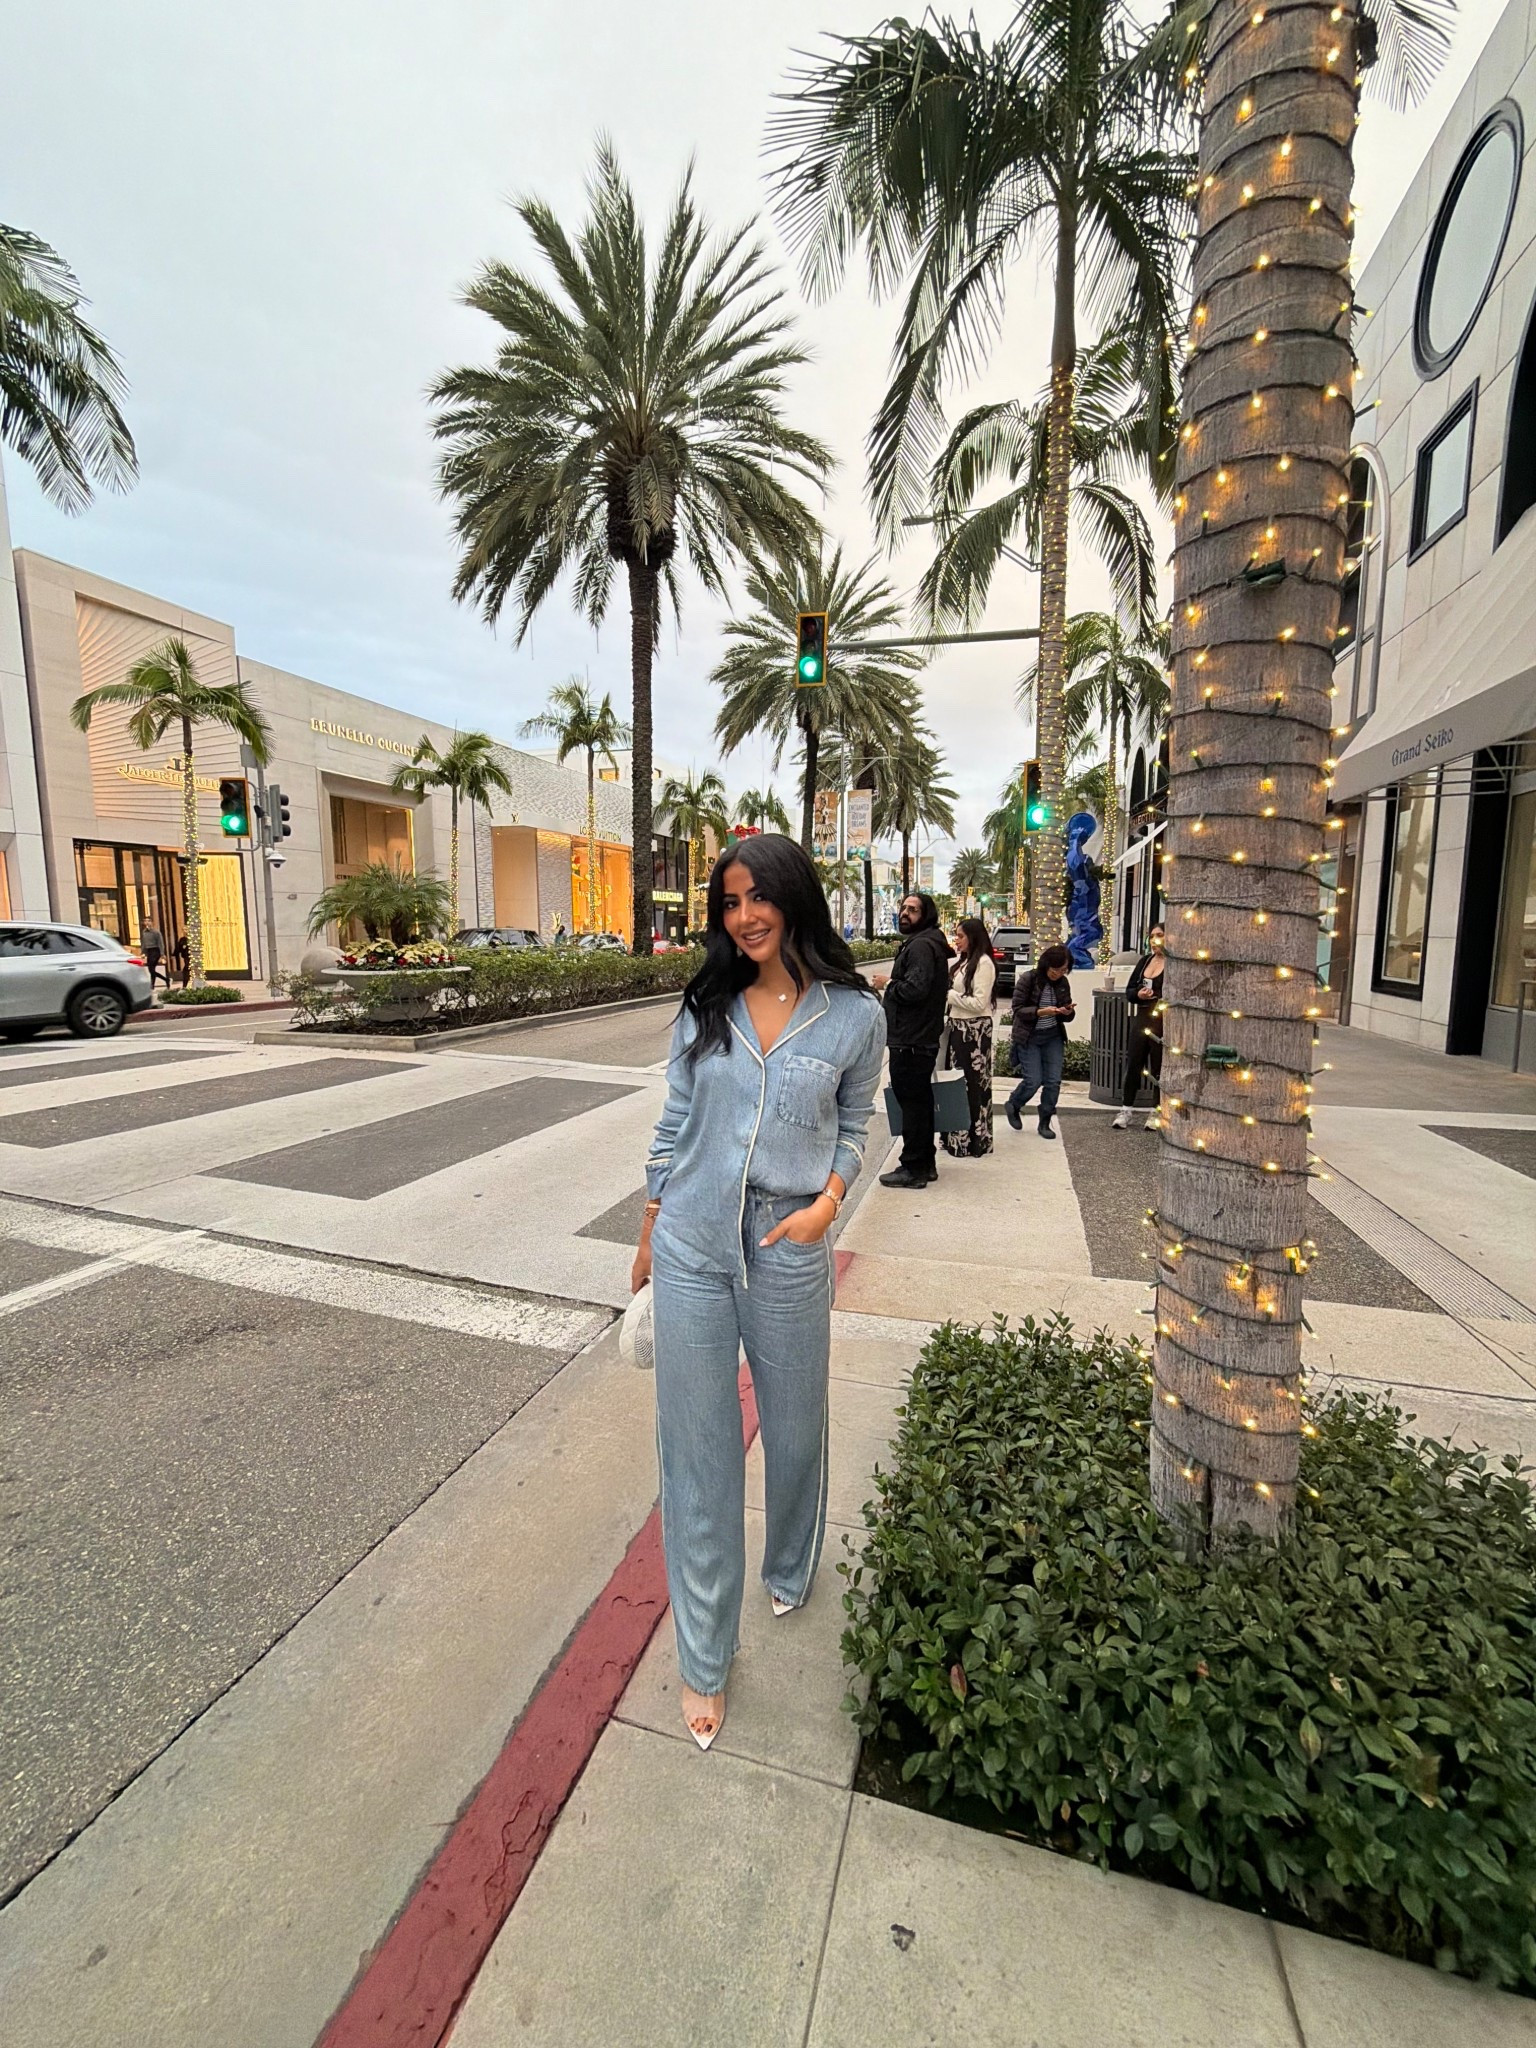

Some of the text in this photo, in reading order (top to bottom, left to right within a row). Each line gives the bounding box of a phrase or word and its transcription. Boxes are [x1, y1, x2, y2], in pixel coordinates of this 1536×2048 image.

[310, 718, 432, 761] BRUNELLO CUCINE
[1391, 727, 1454, 767] Grand Seiko
